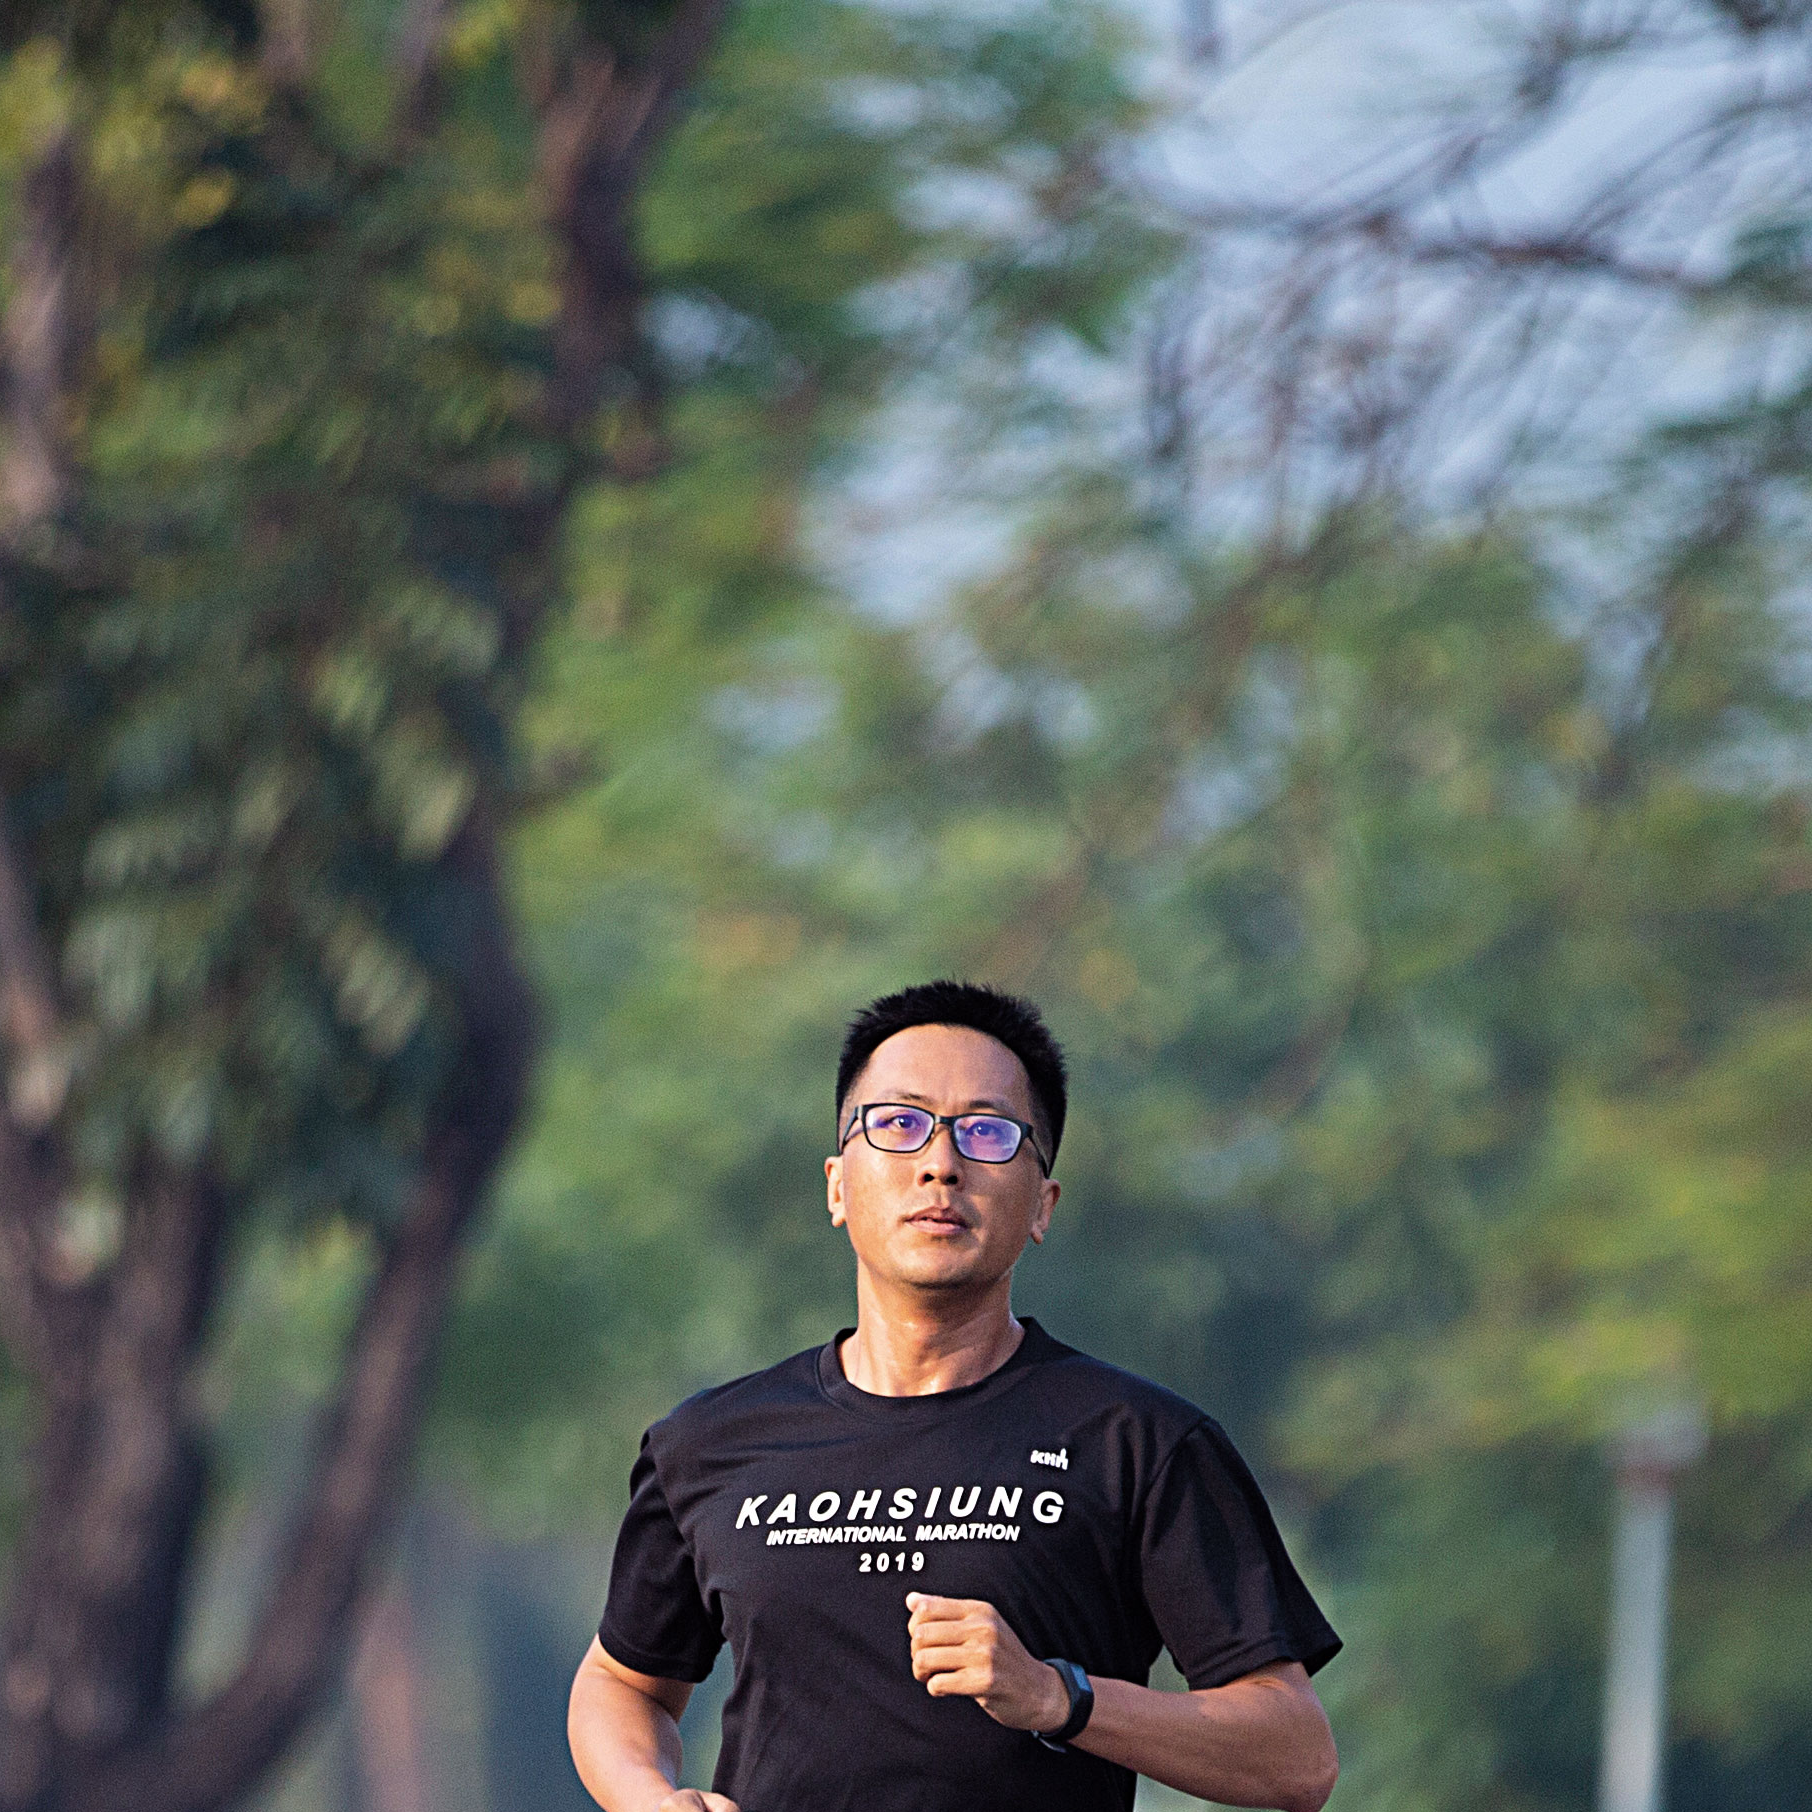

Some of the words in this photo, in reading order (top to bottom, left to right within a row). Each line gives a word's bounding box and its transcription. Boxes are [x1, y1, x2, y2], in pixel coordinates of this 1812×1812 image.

[735, 1485, 1065, 1530] KAOHSIUNG
[765, 1525, 907, 1546] INTERNATIONAL
[914, 1522, 1021, 1543] MARATHON
[858, 1551, 925, 1573] 2019
